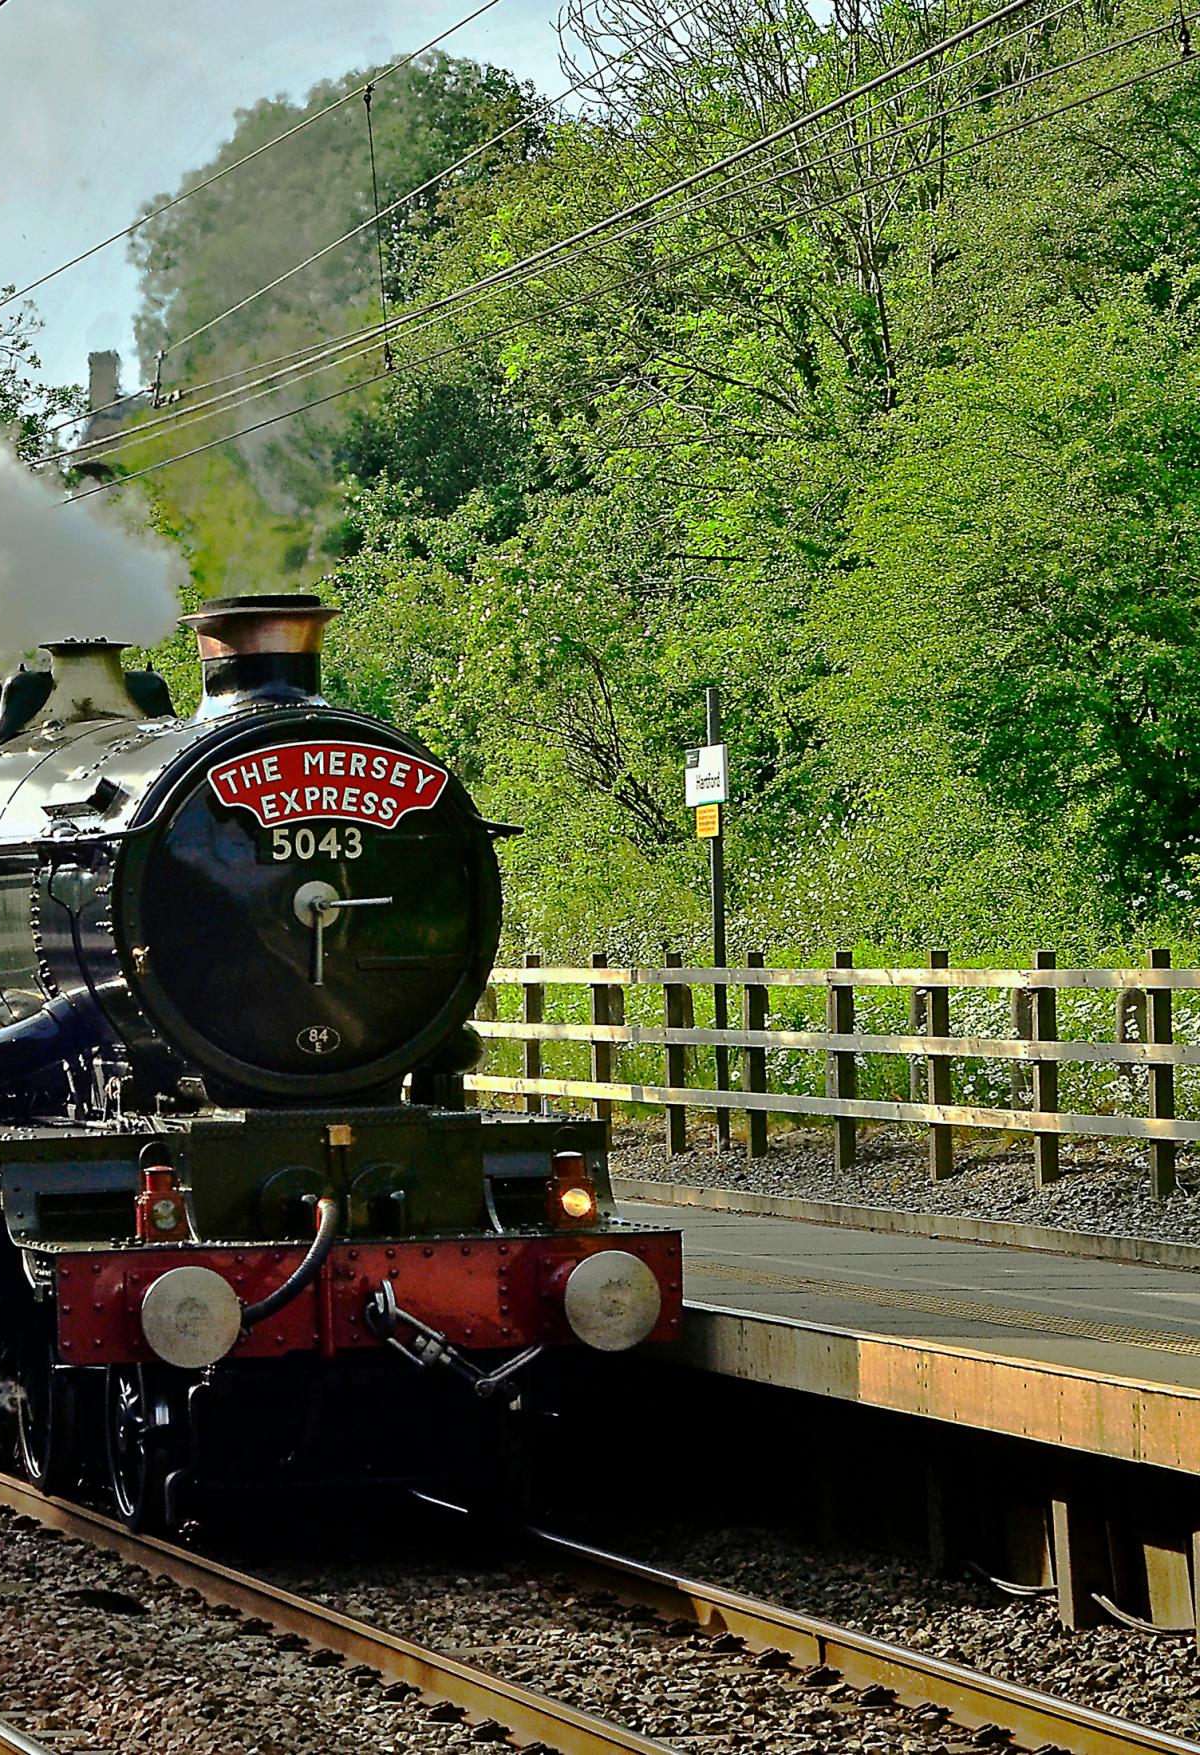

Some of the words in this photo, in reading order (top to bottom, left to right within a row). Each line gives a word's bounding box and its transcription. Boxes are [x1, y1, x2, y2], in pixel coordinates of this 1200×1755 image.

[218, 756, 283, 794] THE
[303, 751, 436, 795] MERSEY
[260, 786, 399, 820] EXPRESS
[272, 827, 363, 861] 5043
[309, 1029, 328, 1042] 84
[315, 1042, 322, 1053] E
